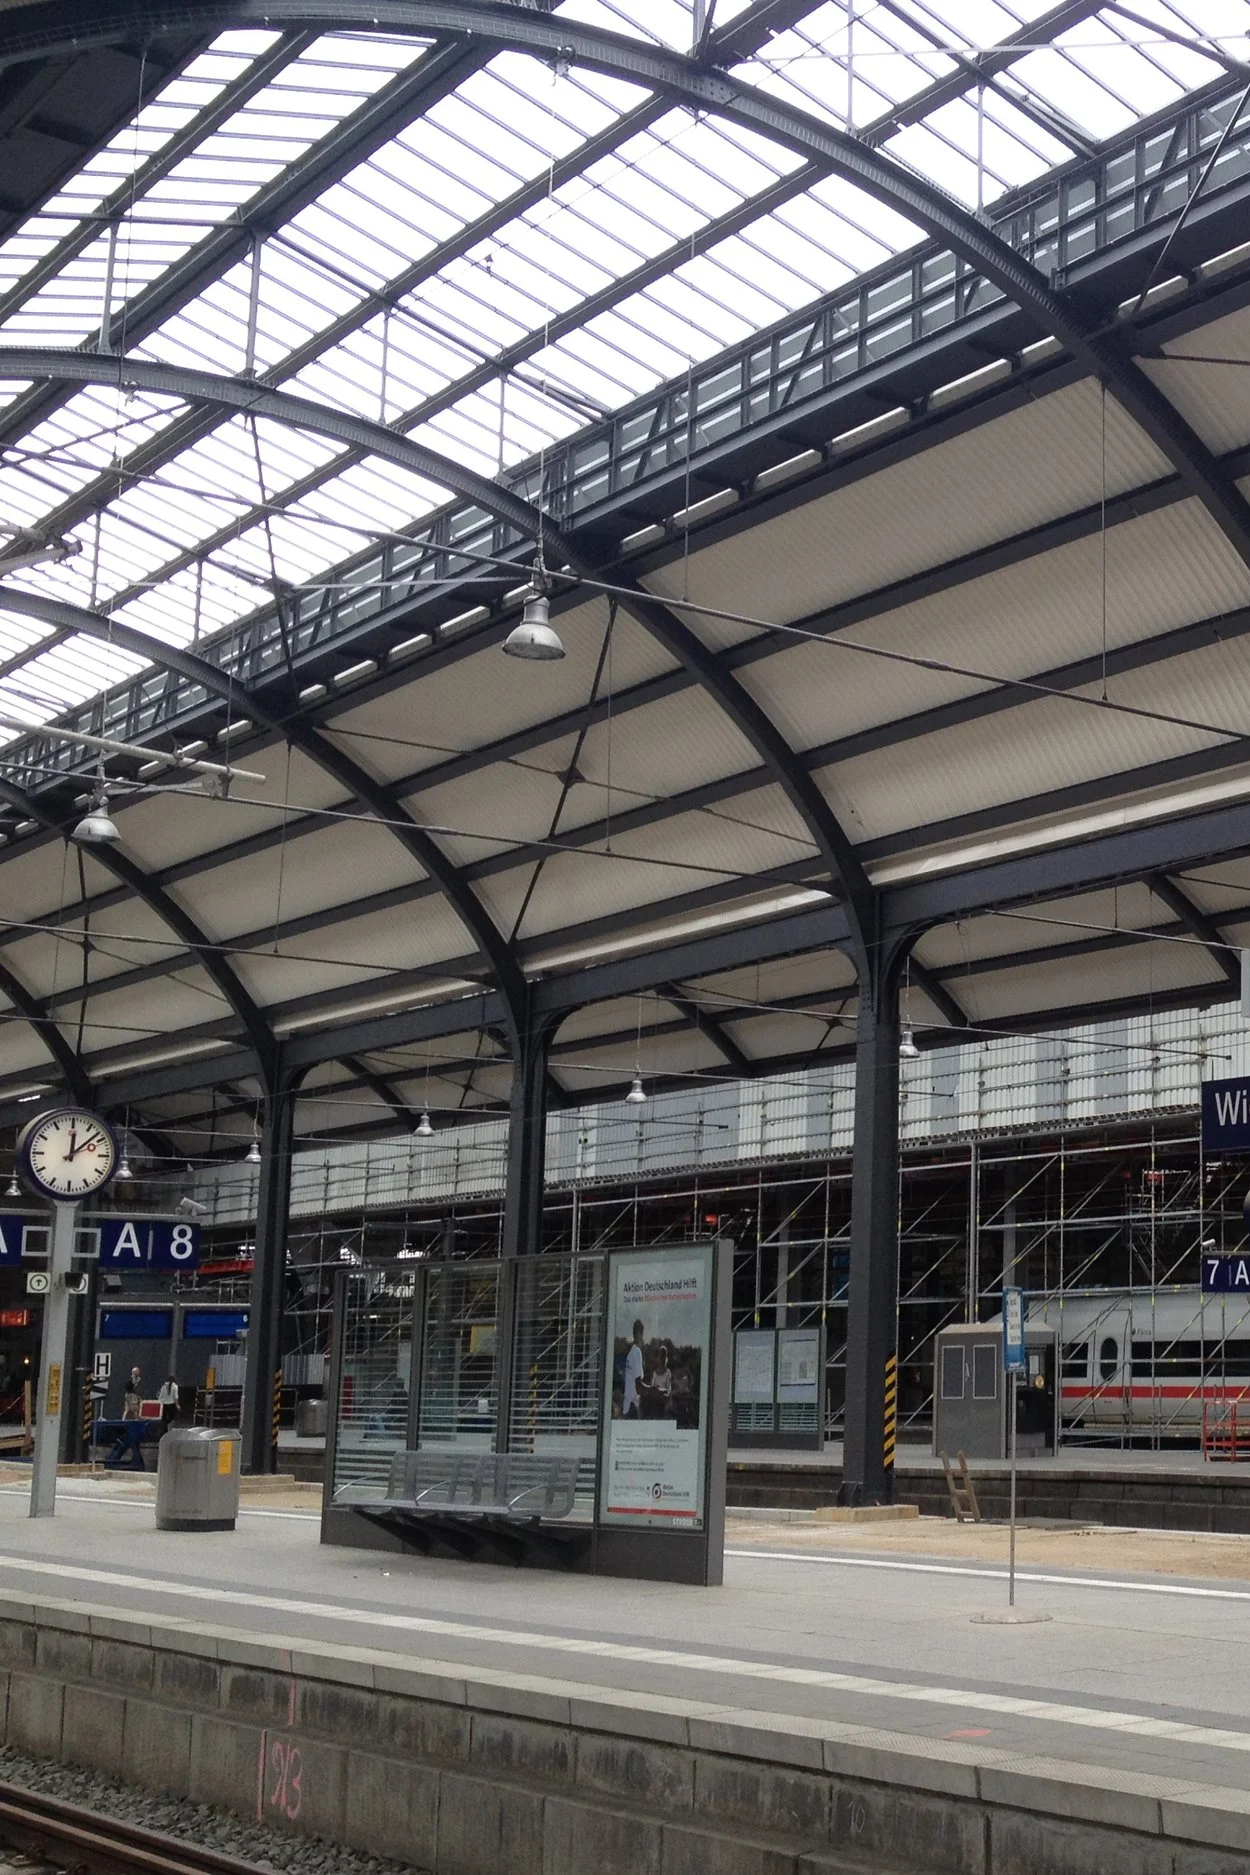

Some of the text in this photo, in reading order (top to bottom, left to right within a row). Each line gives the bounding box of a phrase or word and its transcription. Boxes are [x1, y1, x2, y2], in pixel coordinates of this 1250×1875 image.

[112, 1222, 193, 1260] A 8
[1207, 1260, 1250, 1285] 7 A
[644, 1279, 682, 1292] Deutschland
[96, 1355, 109, 1376] H
